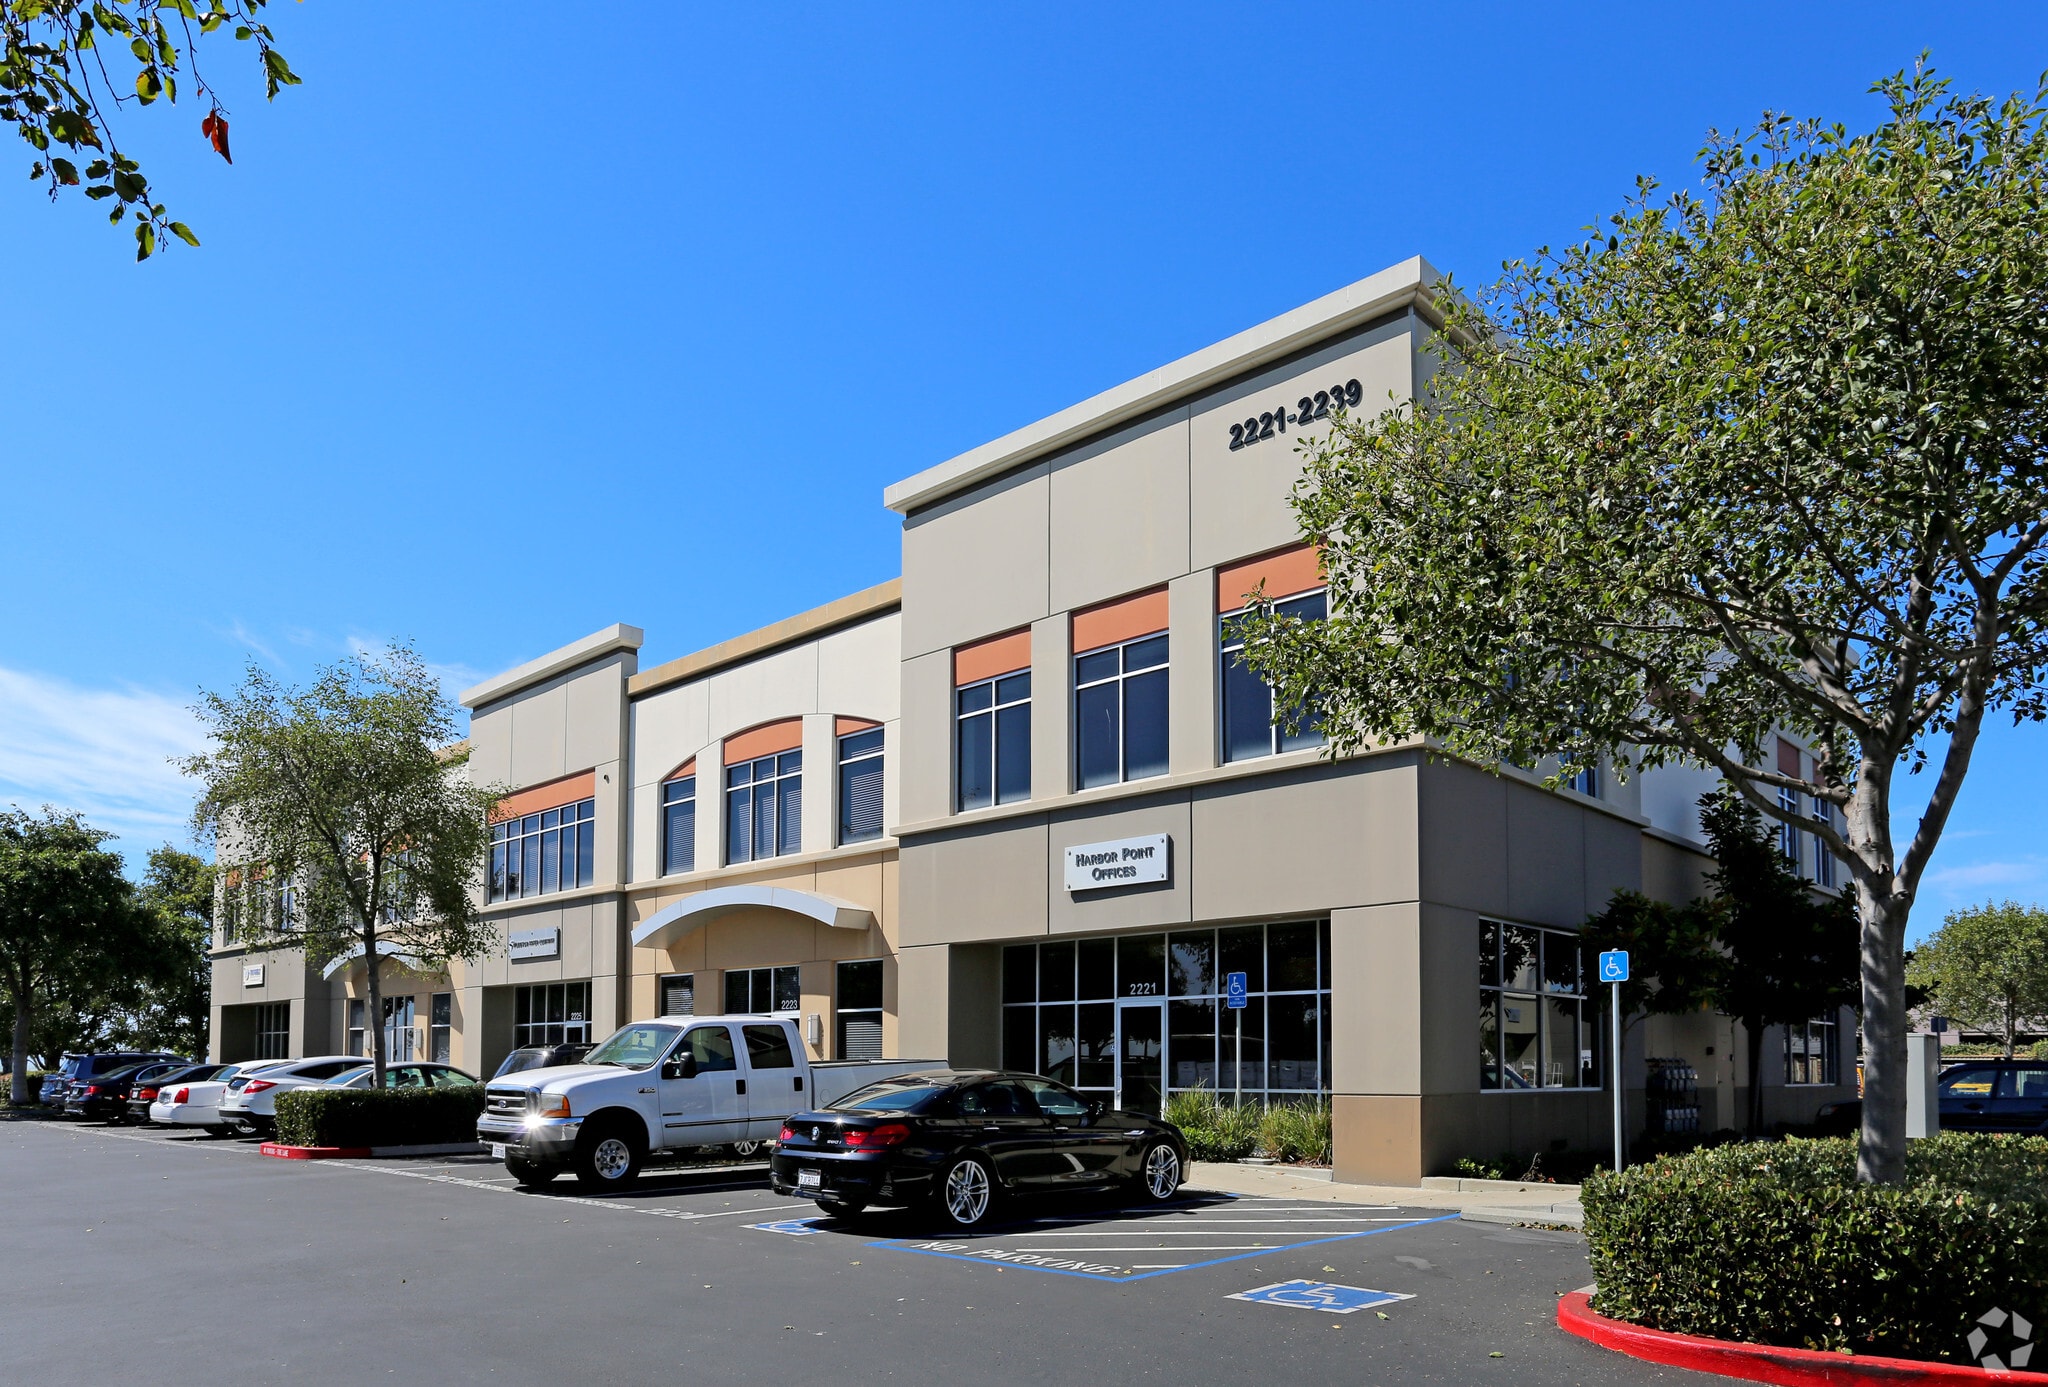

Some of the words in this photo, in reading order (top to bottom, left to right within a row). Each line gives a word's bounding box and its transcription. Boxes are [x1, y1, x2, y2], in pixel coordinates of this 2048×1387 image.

[1229, 378, 1363, 452] 2221-2239
[1075, 851, 1118, 867] HARBOR
[1122, 846, 1155, 861] POINT
[1092, 865, 1137, 881] OFFICES
[1130, 982, 1156, 995] 2221
[781, 999, 798, 1010] 2223
[570, 1012, 583, 1021] 2225
[911, 1241, 969, 1252] NO
[966, 1248, 1120, 1273] PARKING
